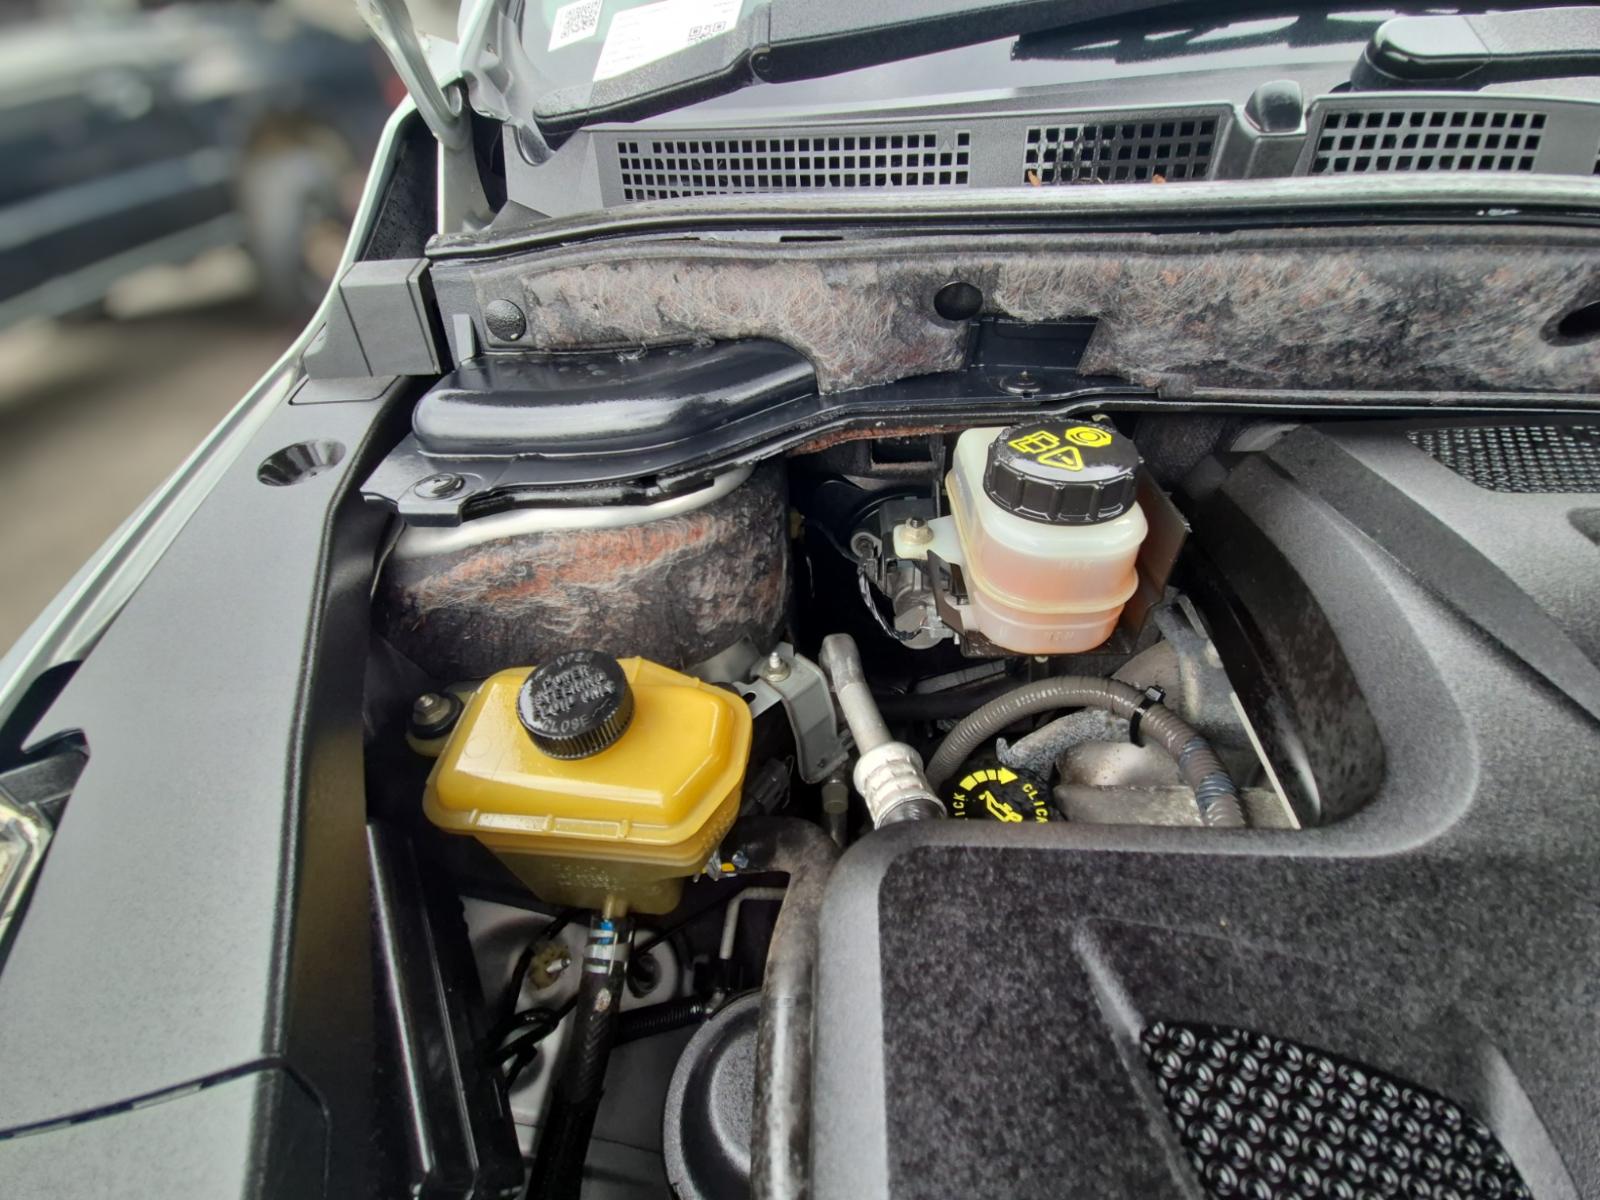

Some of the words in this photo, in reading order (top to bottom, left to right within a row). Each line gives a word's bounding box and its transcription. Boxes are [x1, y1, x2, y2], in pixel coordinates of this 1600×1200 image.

[535, 672, 607, 705] STEERING
[542, 665, 589, 689] POWER
[542, 715, 590, 732] CLOSE
[953, 793, 965, 816] ICK
